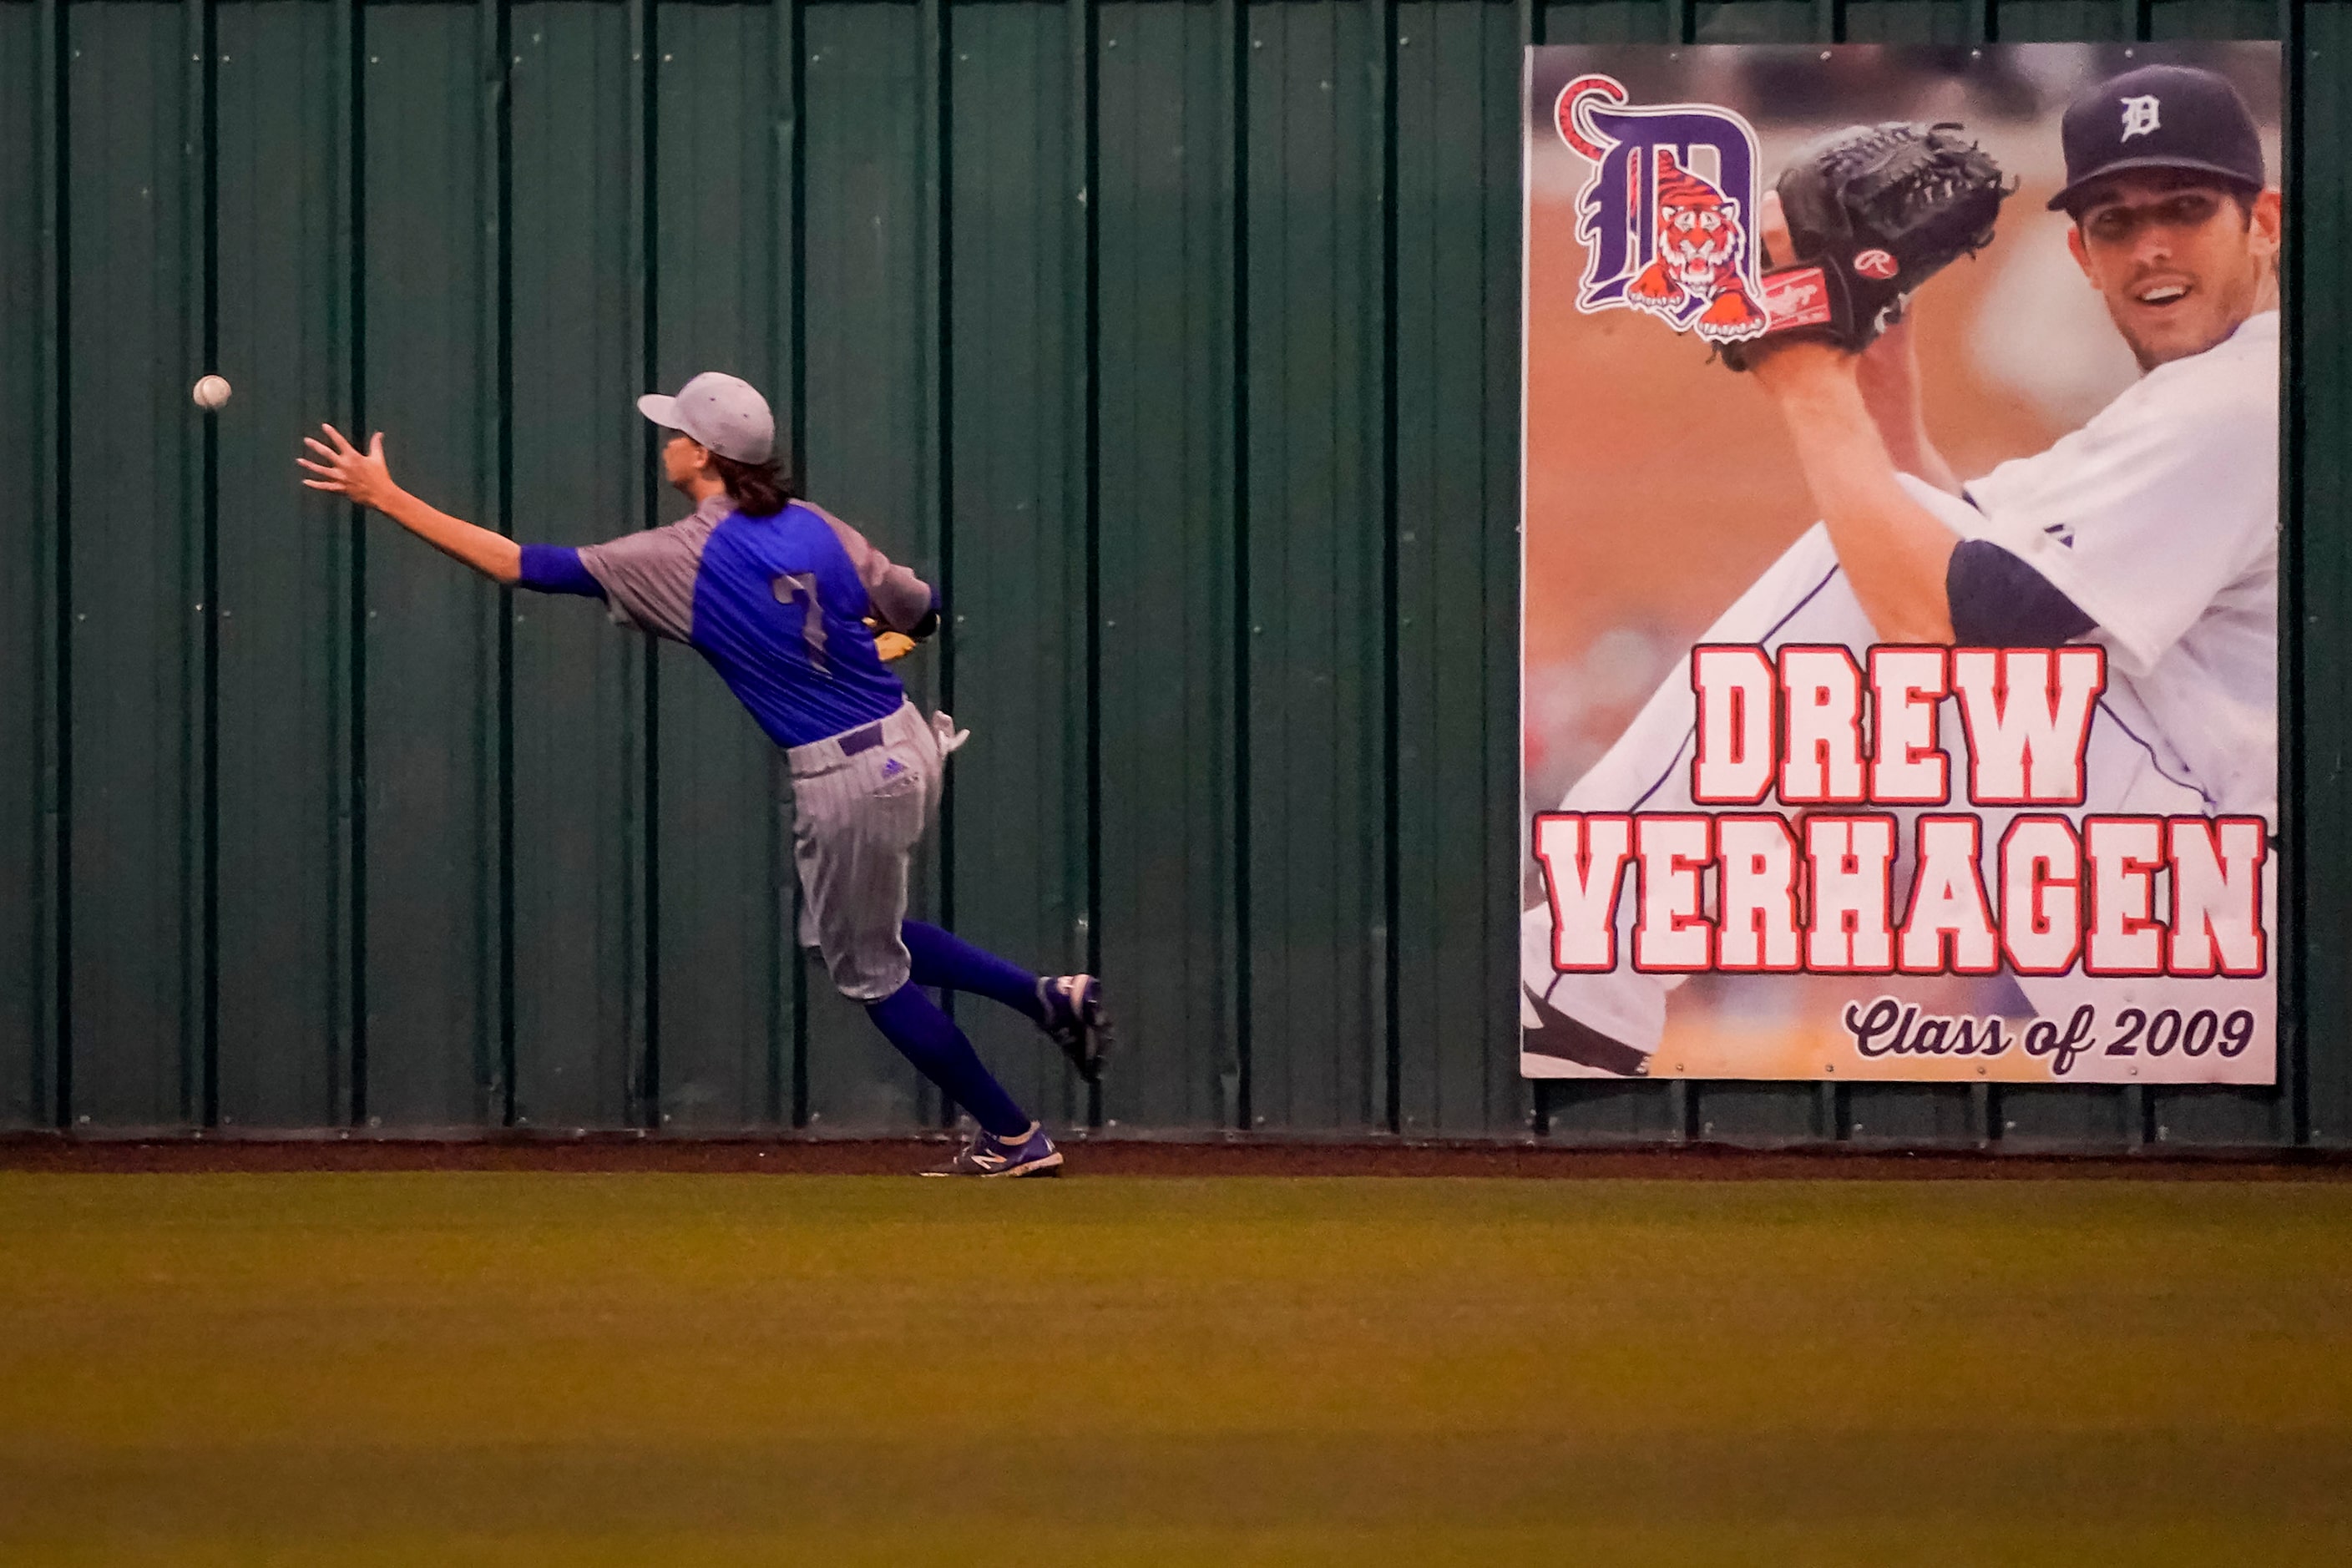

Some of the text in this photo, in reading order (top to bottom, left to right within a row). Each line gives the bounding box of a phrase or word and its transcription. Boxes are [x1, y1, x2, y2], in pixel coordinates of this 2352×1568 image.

[2121, 94, 2161, 143] D
[771, 572, 833, 680] 7
[1692, 645, 2107, 807] DREW
[1533, 812, 2269, 979] VERHAGEN
[1845, 999, 2254, 1076] Class of 2009
